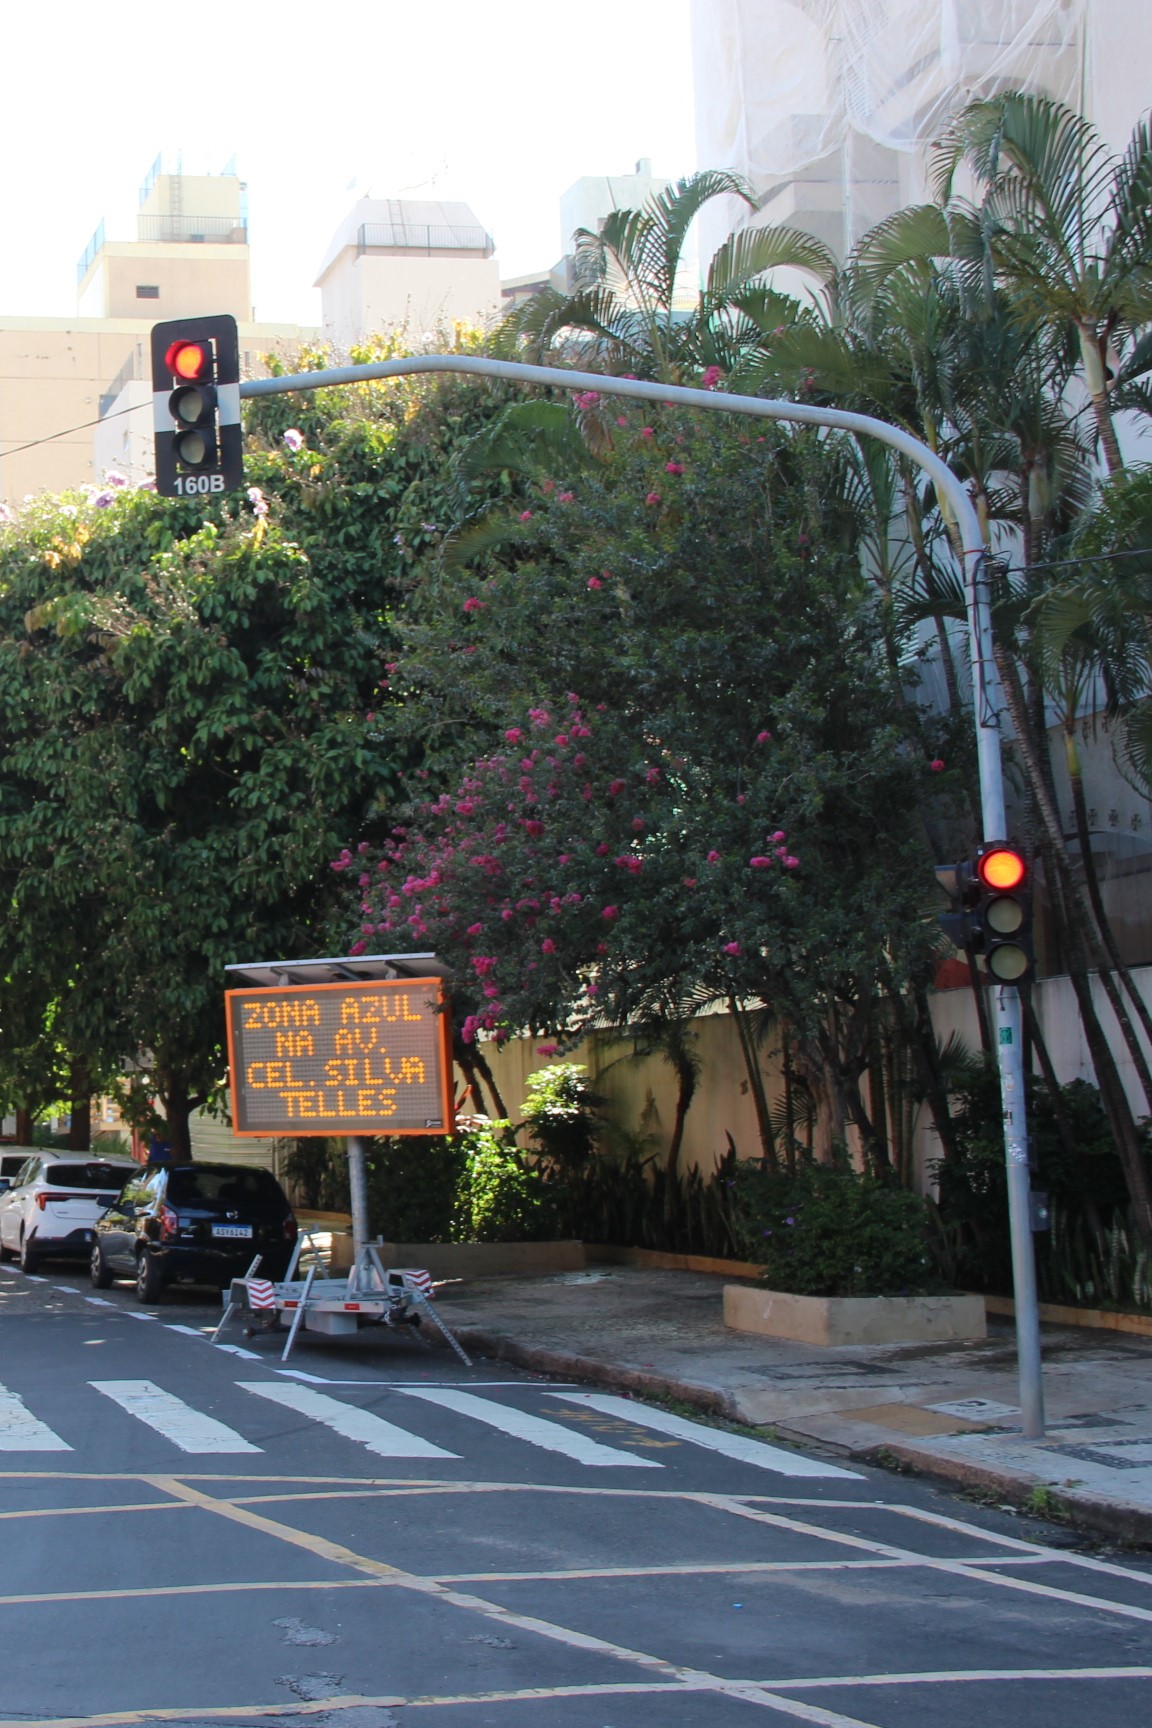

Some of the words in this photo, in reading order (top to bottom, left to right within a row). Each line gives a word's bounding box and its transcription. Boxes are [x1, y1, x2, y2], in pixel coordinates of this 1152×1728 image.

[174, 474, 225, 495] 160B
[243, 999, 321, 1028] ZONA
[340, 994, 422, 1024] AZUL
[275, 1030, 314, 1057] NA
[334, 1027, 387, 1054] AV.
[279, 1088, 397, 1117] TELLES
